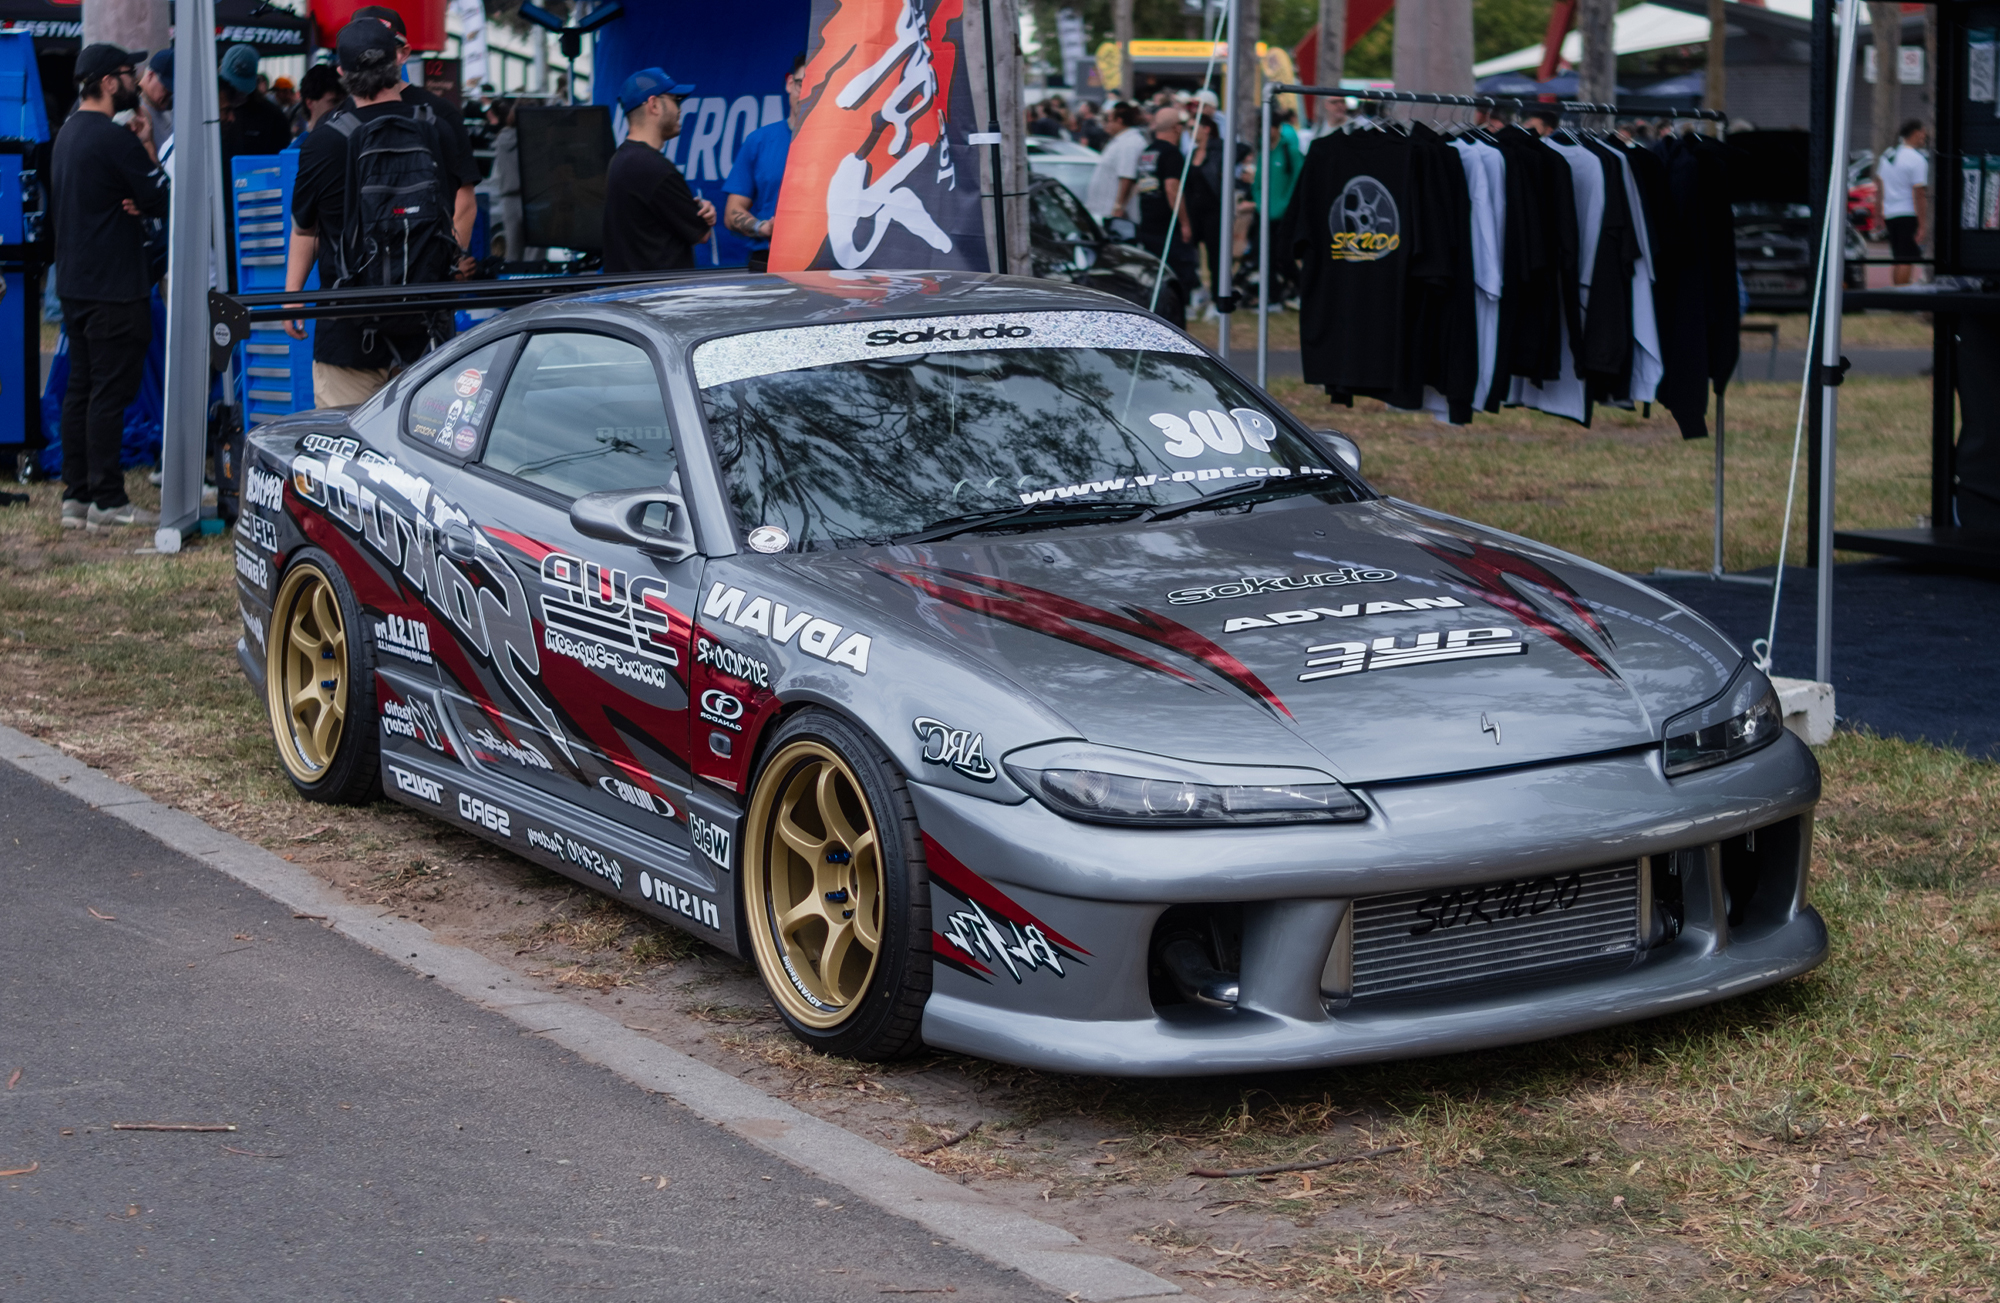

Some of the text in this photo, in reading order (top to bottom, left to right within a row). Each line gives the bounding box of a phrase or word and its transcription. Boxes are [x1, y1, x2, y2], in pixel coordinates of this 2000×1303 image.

[222, 25, 305, 45] FESTIVAL
[865, 323, 1032, 347] Sokudo
[1149, 407, 1277, 458] 3UP
[1223, 596, 1465, 633] ADVAN
[1409, 873, 1582, 936] SOKUDO
[782, 955, 823, 1008] ADVAN Racing
